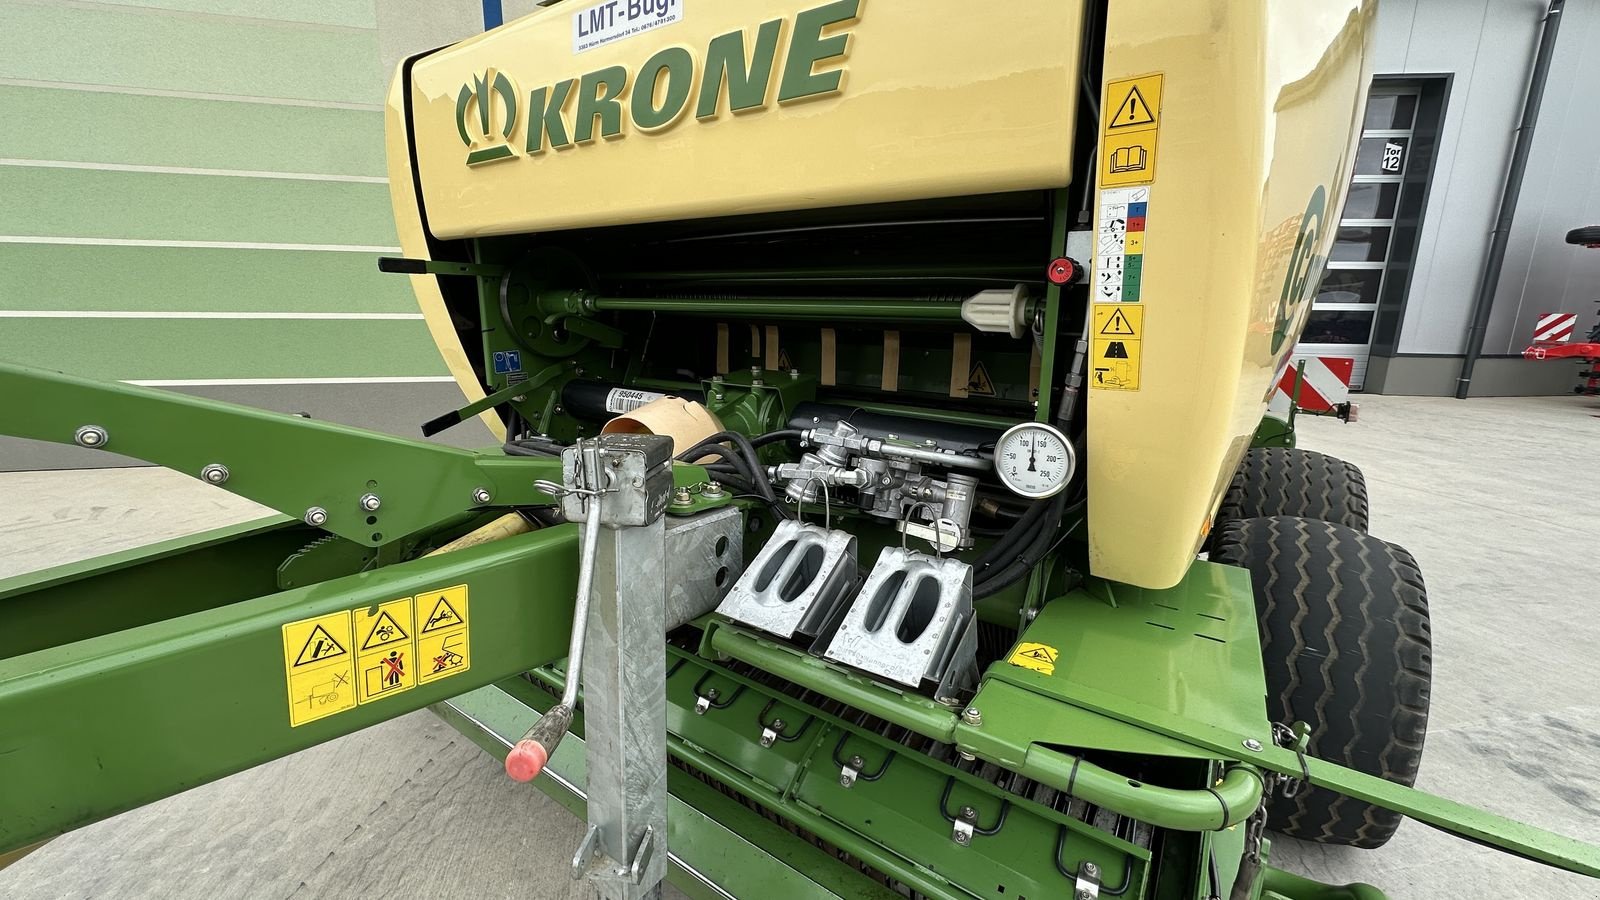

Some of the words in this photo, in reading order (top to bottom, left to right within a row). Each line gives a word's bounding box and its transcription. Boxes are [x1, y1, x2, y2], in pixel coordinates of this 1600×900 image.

[578, 0, 675, 37] LMT-Bug
[526, 0, 859, 152] KRONE
[1384, 157, 1399, 168] 12
[618, 390, 643, 400] 950445
[1037, 440, 1047, 448] 150
[1040, 470, 1050, 478] 250
